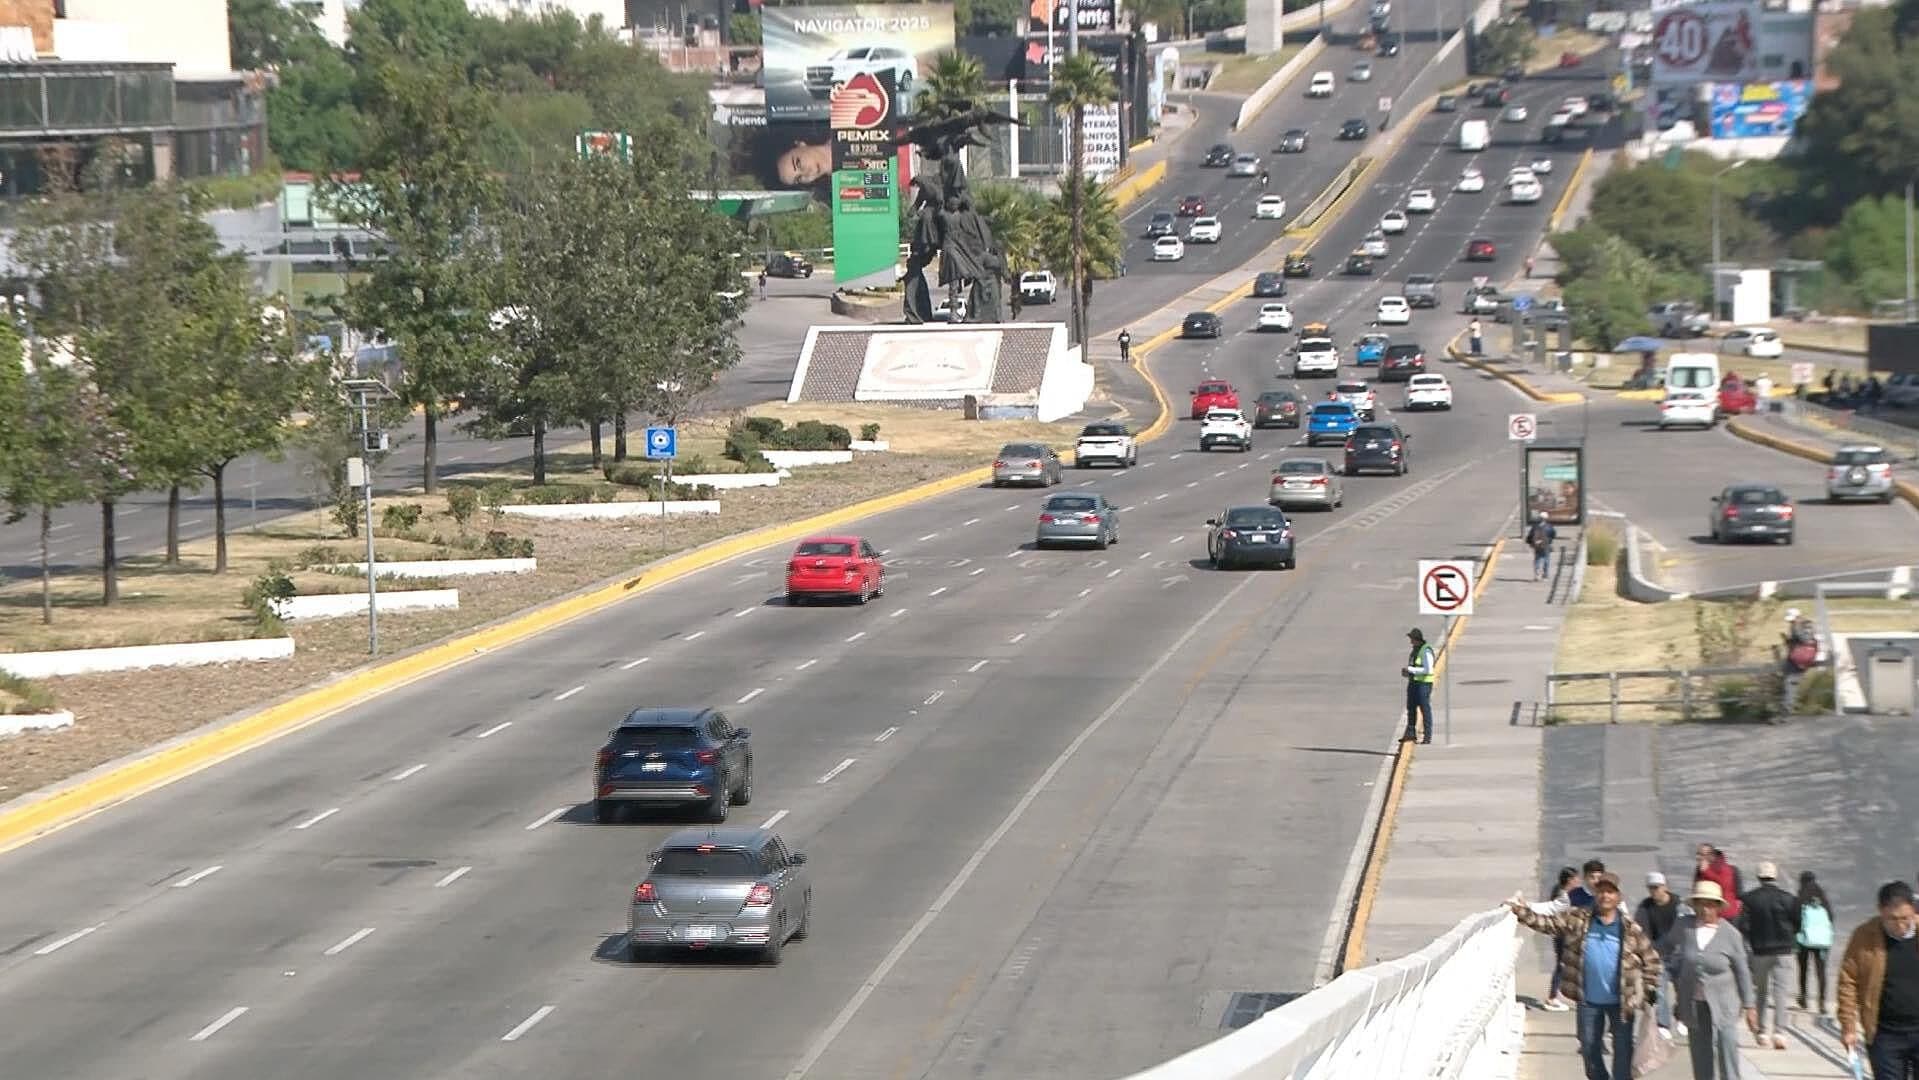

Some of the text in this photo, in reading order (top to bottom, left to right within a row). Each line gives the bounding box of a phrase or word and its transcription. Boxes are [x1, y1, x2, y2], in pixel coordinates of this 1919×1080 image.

[794, 16, 930, 33] NAVIGATOR 2025
[1058, 7, 1110, 25] Pente
[1659, 18, 1702, 61] 40
[837, 129, 890, 142] PEMEX
[1435, 573, 1458, 602] E
